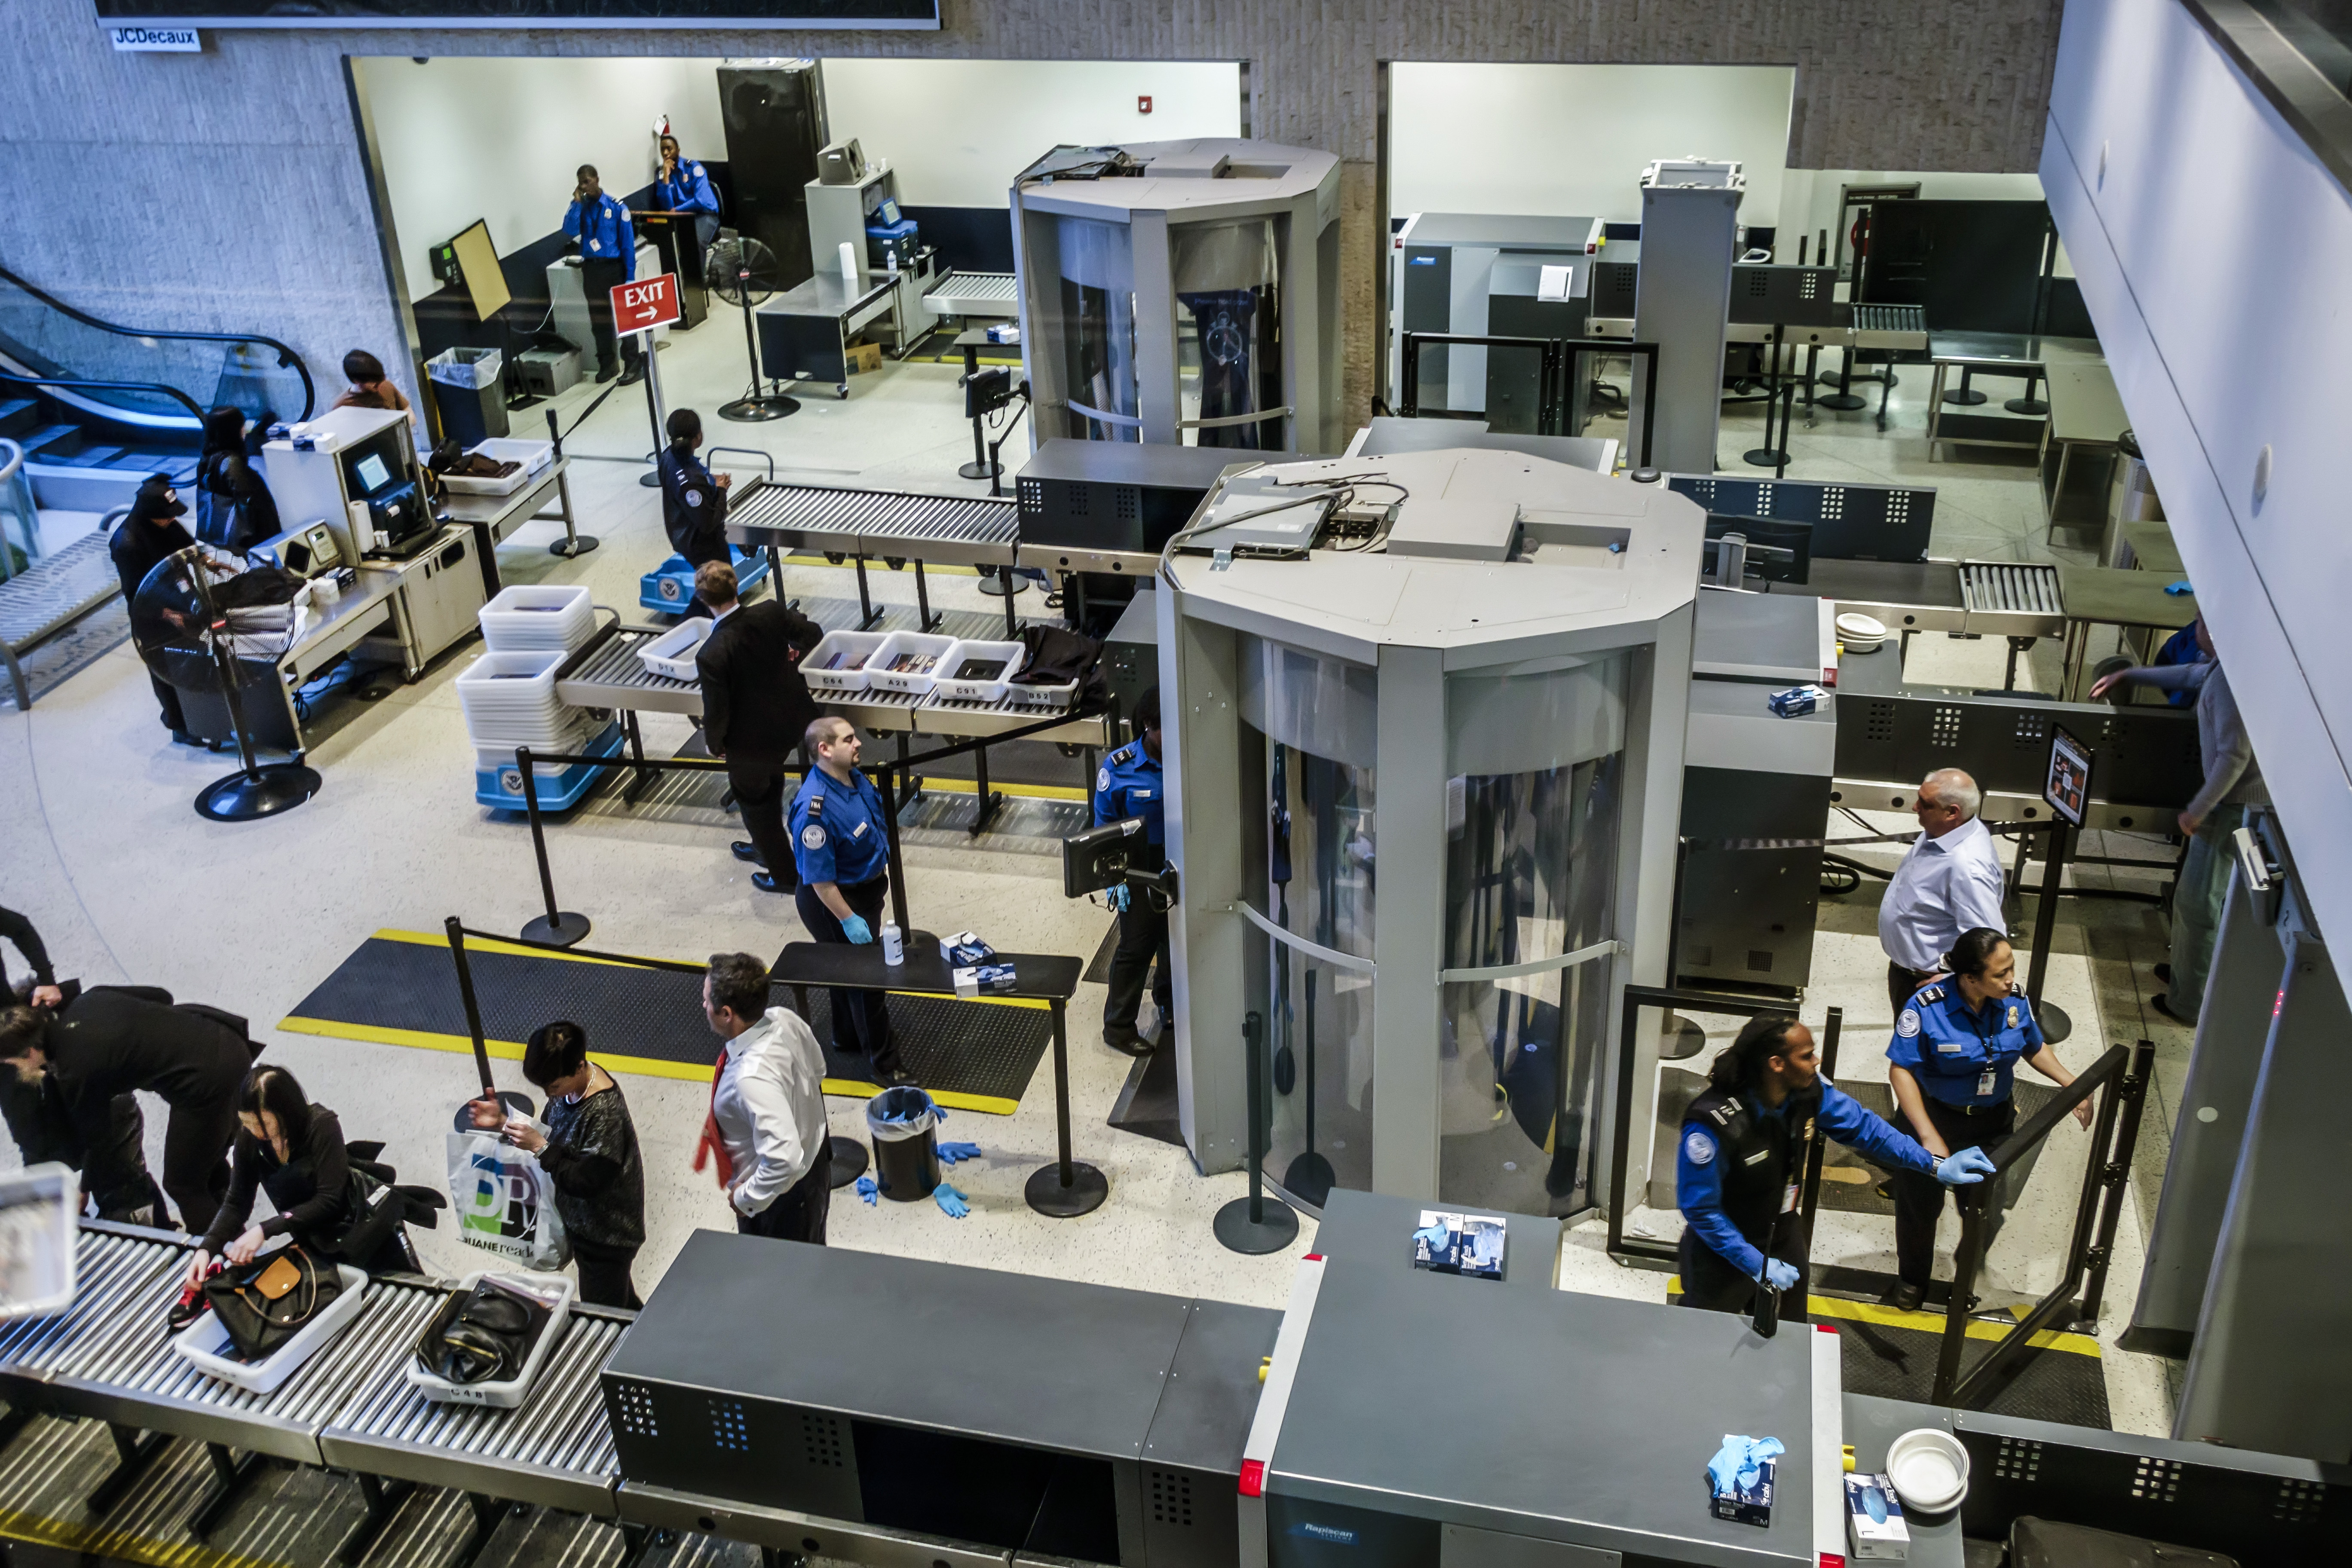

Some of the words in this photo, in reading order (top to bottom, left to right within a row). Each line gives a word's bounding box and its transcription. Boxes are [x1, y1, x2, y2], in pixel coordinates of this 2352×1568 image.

[116, 28, 196, 43] JCDecaux
[625, 281, 665, 308] EXIT
[1305, 1523, 1352, 1537] Rapiscan
